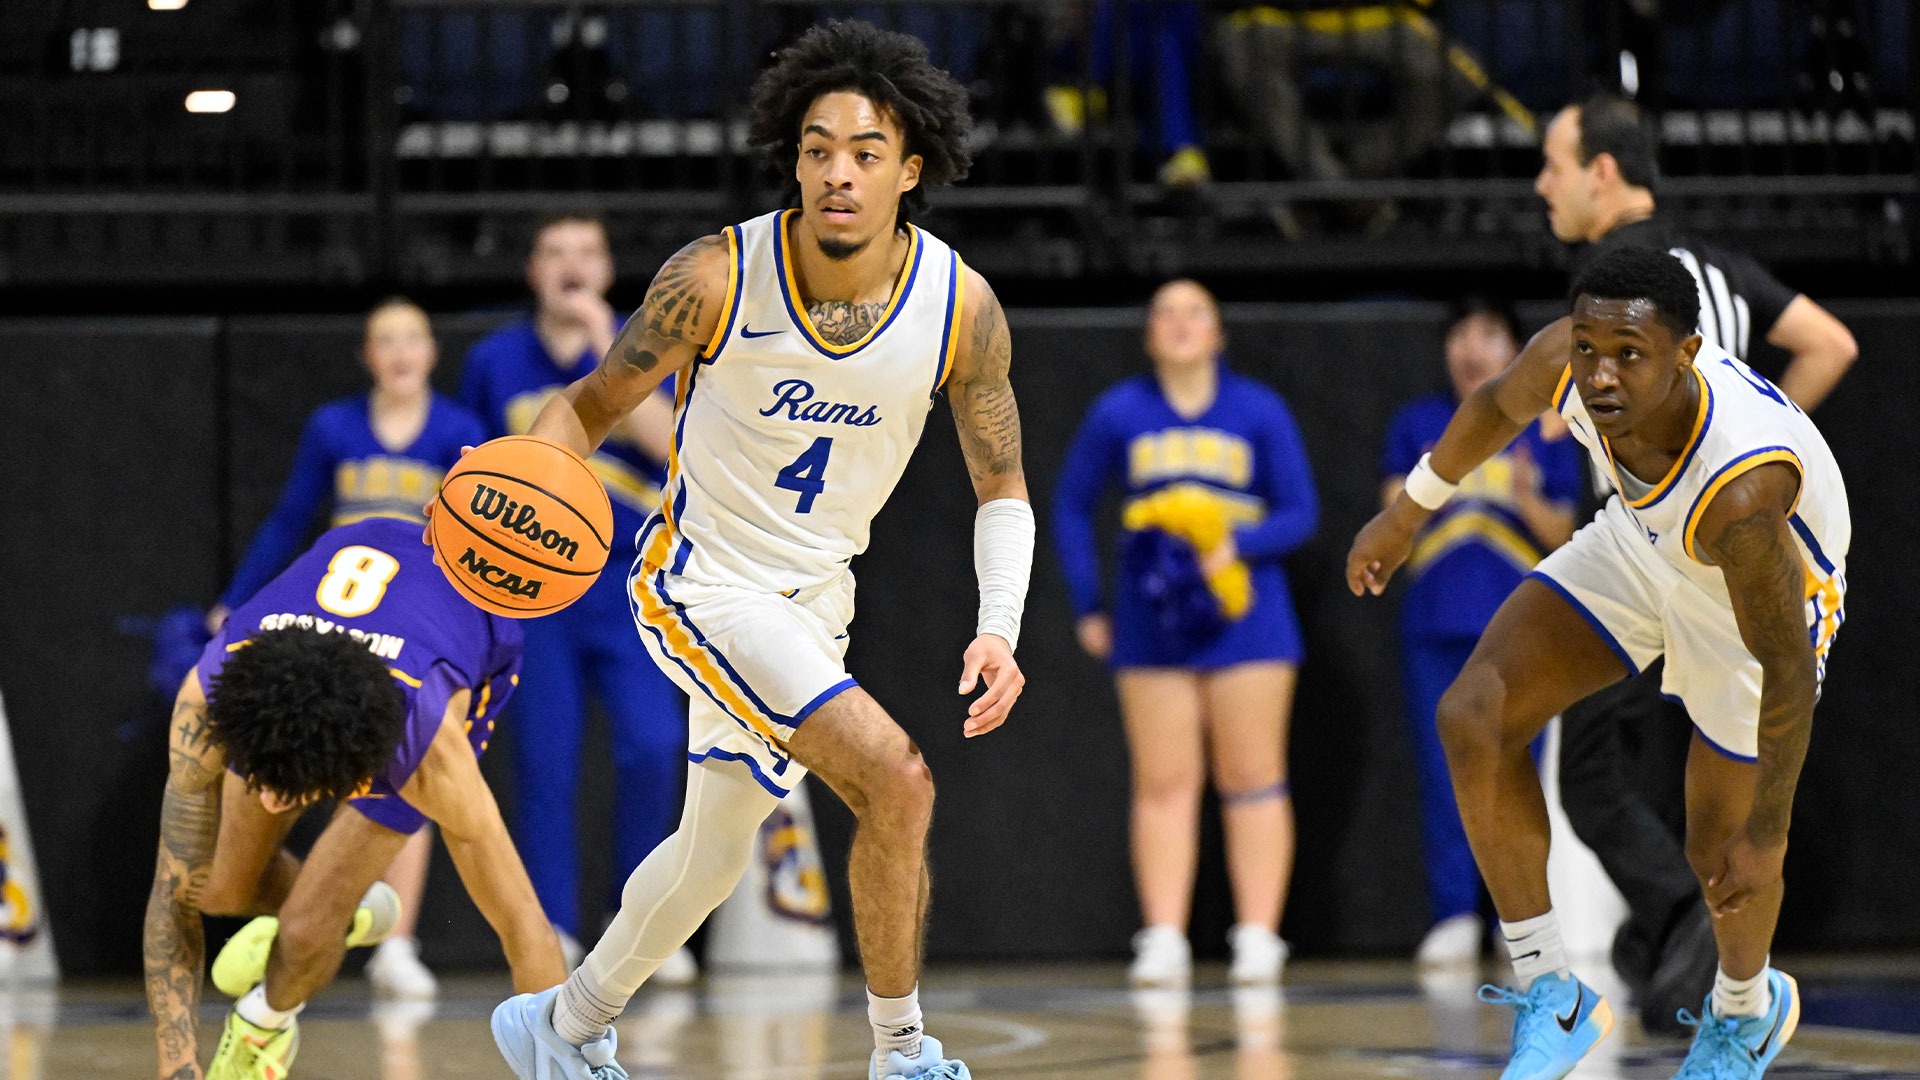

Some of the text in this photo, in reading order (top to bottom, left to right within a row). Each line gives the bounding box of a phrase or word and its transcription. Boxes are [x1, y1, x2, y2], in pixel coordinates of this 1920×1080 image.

[759, 379, 882, 427] Rams
[773, 436, 834, 514] 4
[470, 483, 579, 562] Wilson
[316, 545, 400, 618] 8
[457, 547, 543, 600] NCAA
